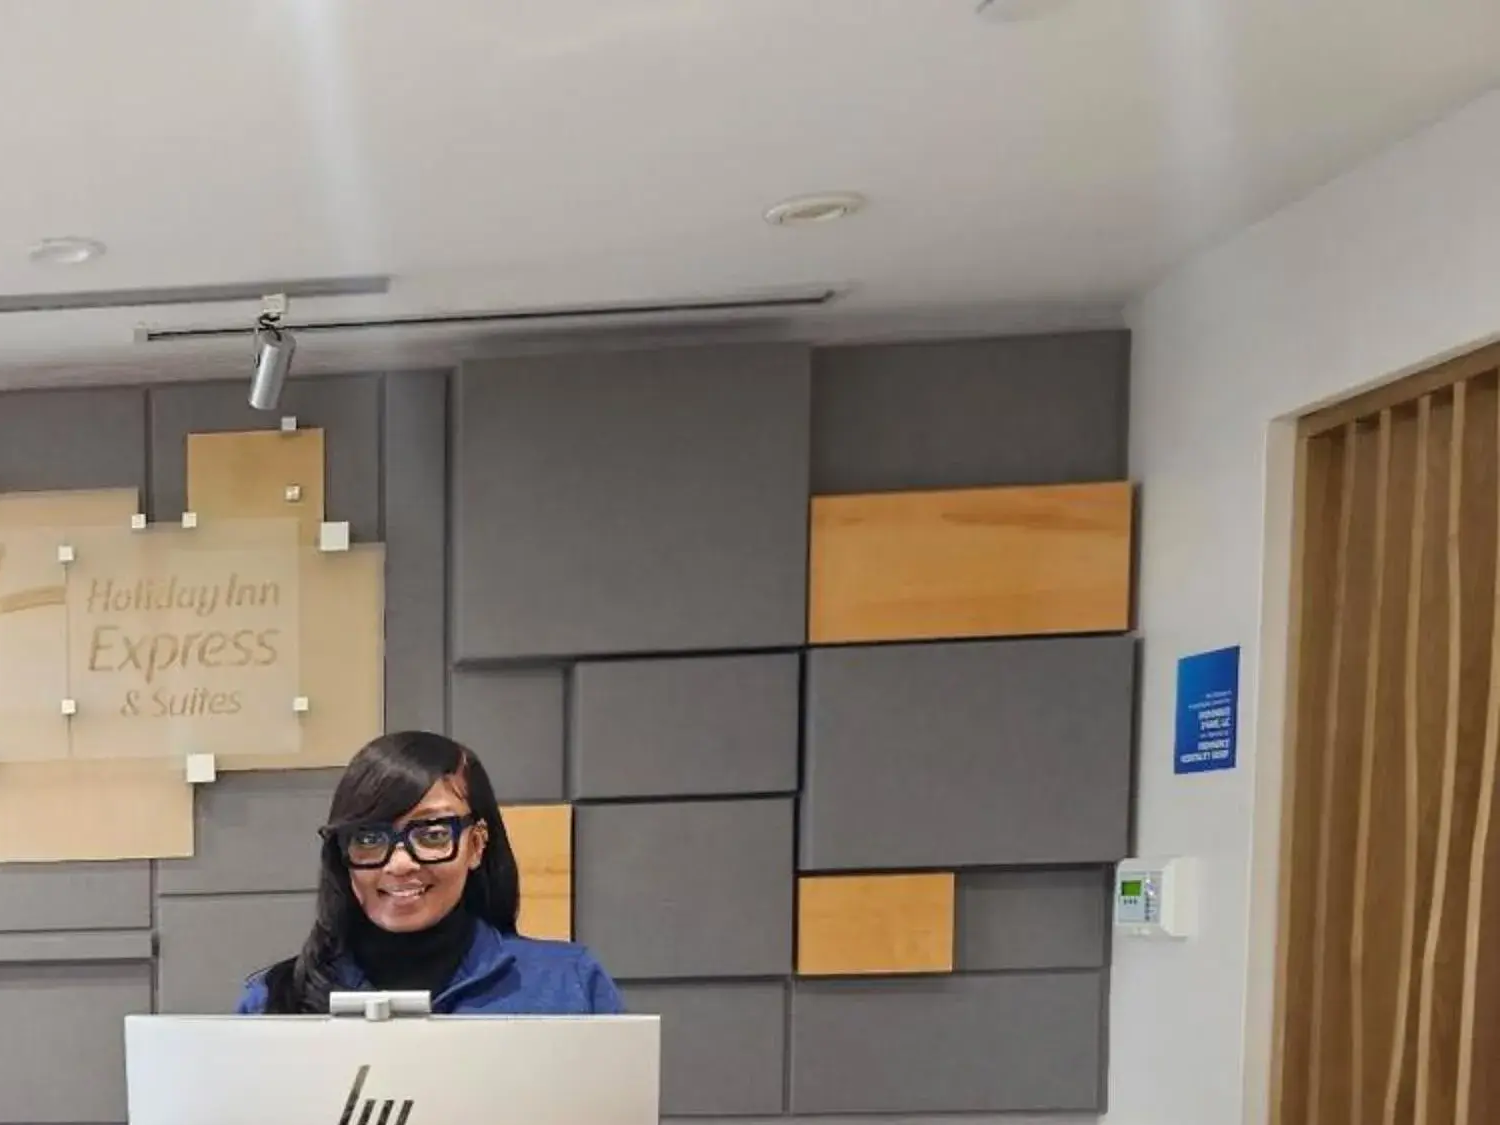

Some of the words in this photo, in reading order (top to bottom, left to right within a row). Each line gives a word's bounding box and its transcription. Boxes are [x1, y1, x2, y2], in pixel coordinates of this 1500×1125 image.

[87, 575, 220, 616] Holiday
[226, 573, 280, 607] Inn
[87, 624, 280, 683] Express
[120, 689, 141, 715] &
[151, 687, 242, 715] Suites
